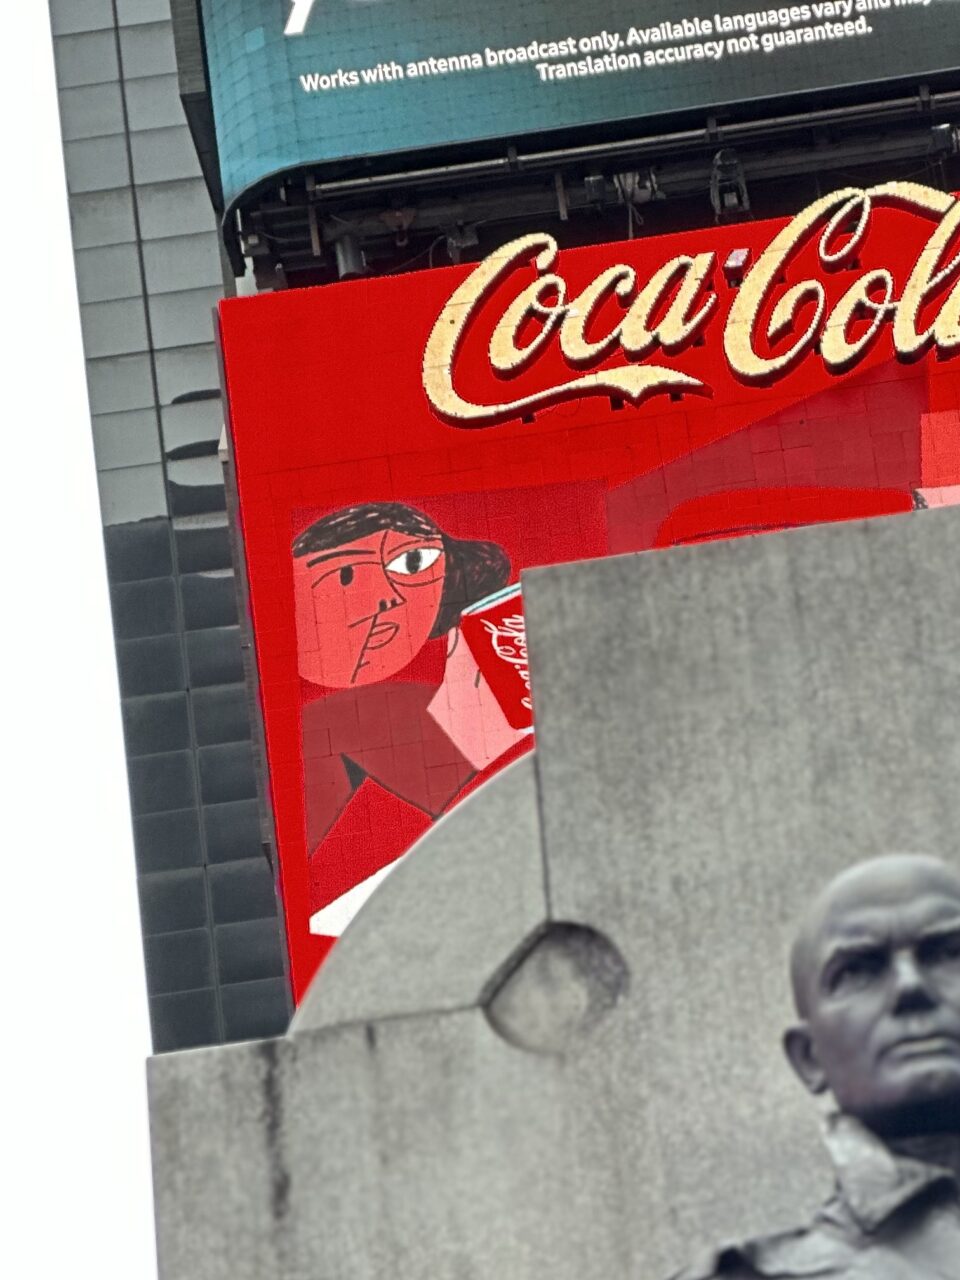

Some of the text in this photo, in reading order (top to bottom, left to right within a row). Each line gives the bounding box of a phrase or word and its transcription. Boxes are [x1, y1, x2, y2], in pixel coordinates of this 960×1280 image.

[299, 68, 359, 92] Works
[360, 61, 404, 84] with
[405, 51, 483, 77] antenna
[484, 36, 578, 66] broadcast
[578, 30, 625, 53] only.
[626, 16, 713, 46] Available
[713, 4, 812, 32] languages
[811, 0, 853, 18] vary
[535, 14, 873, 82] Translation accuracy not guaranteed.
